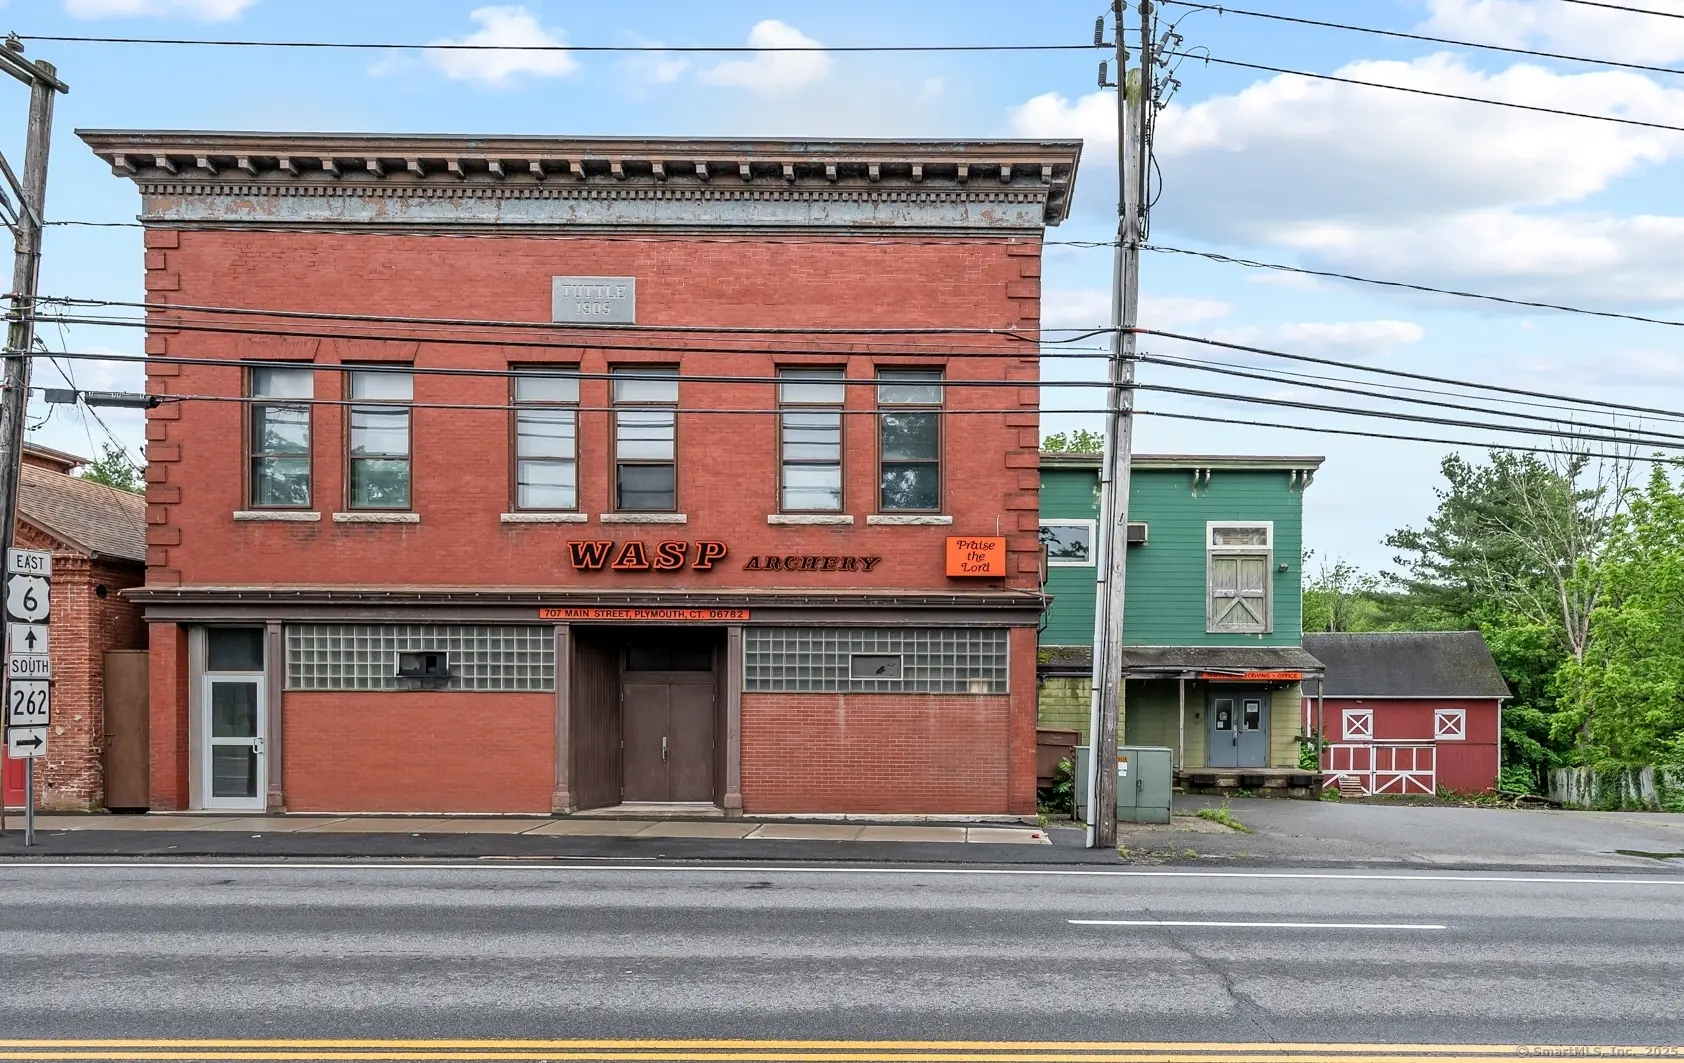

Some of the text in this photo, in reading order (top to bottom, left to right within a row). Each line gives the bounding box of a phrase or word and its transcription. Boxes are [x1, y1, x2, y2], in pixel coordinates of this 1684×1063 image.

[561, 284, 626, 299] TUTTLE
[956, 540, 996, 551] Praise
[16, 554, 45, 571] EAST
[566, 540, 882, 571] WASP ARCHERY
[967, 551, 986, 562] the
[961, 562, 990, 572] Lord
[23, 586, 38, 612] 6
[545, 609, 744, 619] 707 MAIN STREET, PLYMOUTH, CT. 06782
[12, 659, 49, 674] SOUTH
[13, 690, 47, 716] 262
